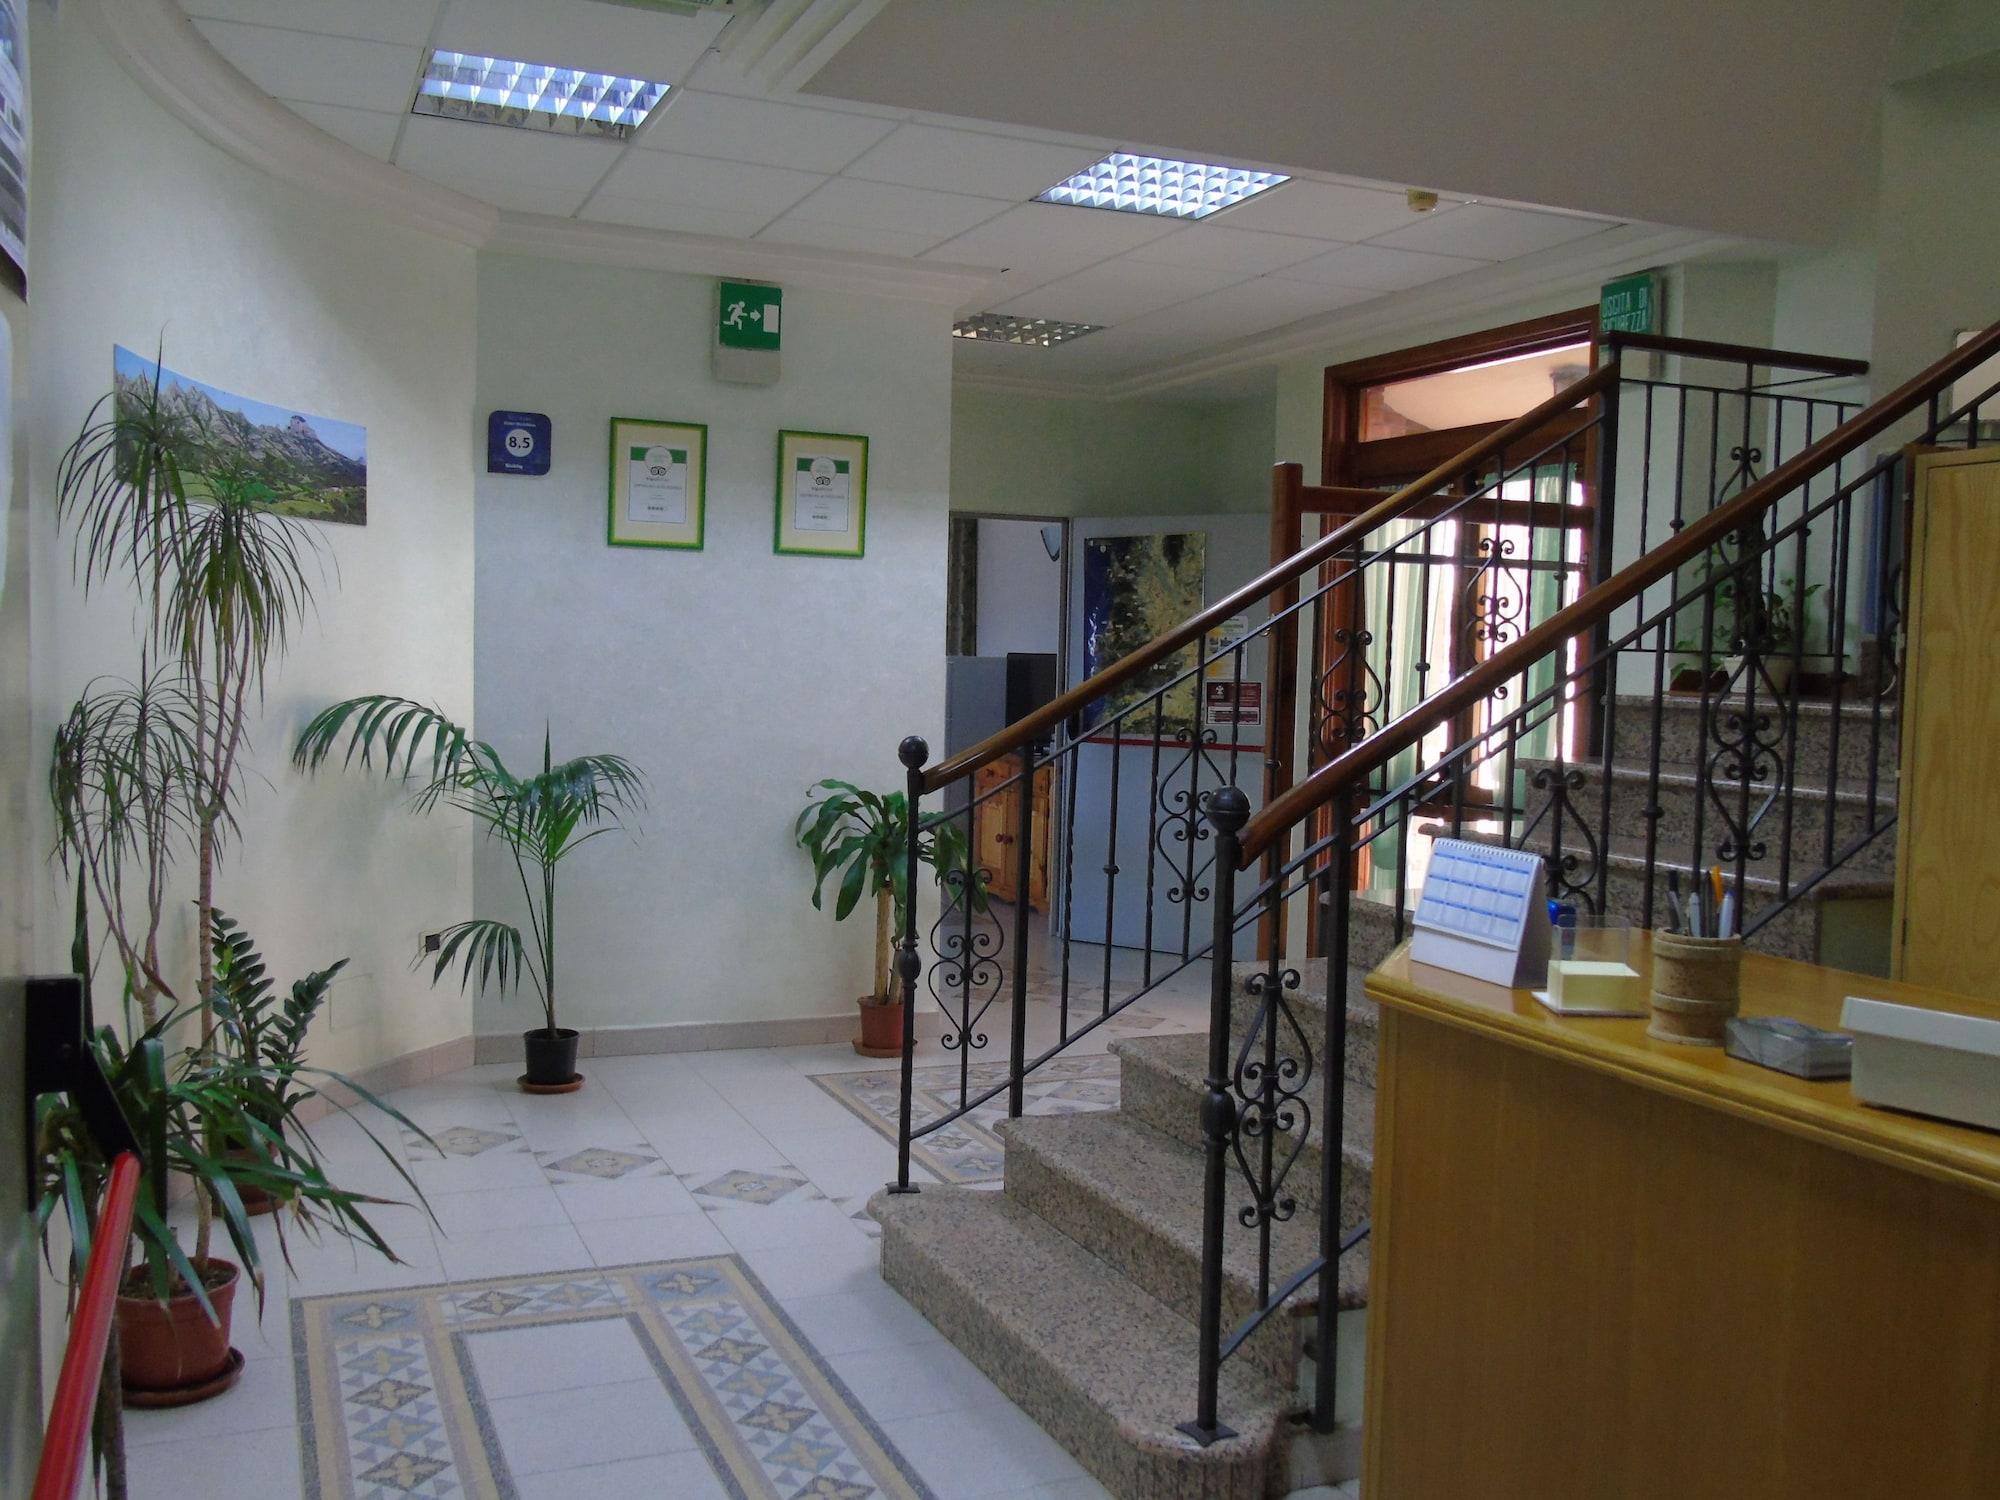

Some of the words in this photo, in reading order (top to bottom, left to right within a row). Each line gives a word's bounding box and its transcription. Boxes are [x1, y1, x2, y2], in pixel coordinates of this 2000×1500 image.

[1602, 291, 1631, 318] USCITA
[1638, 287, 1648, 309] DI
[509, 436, 530, 449] 8.5
